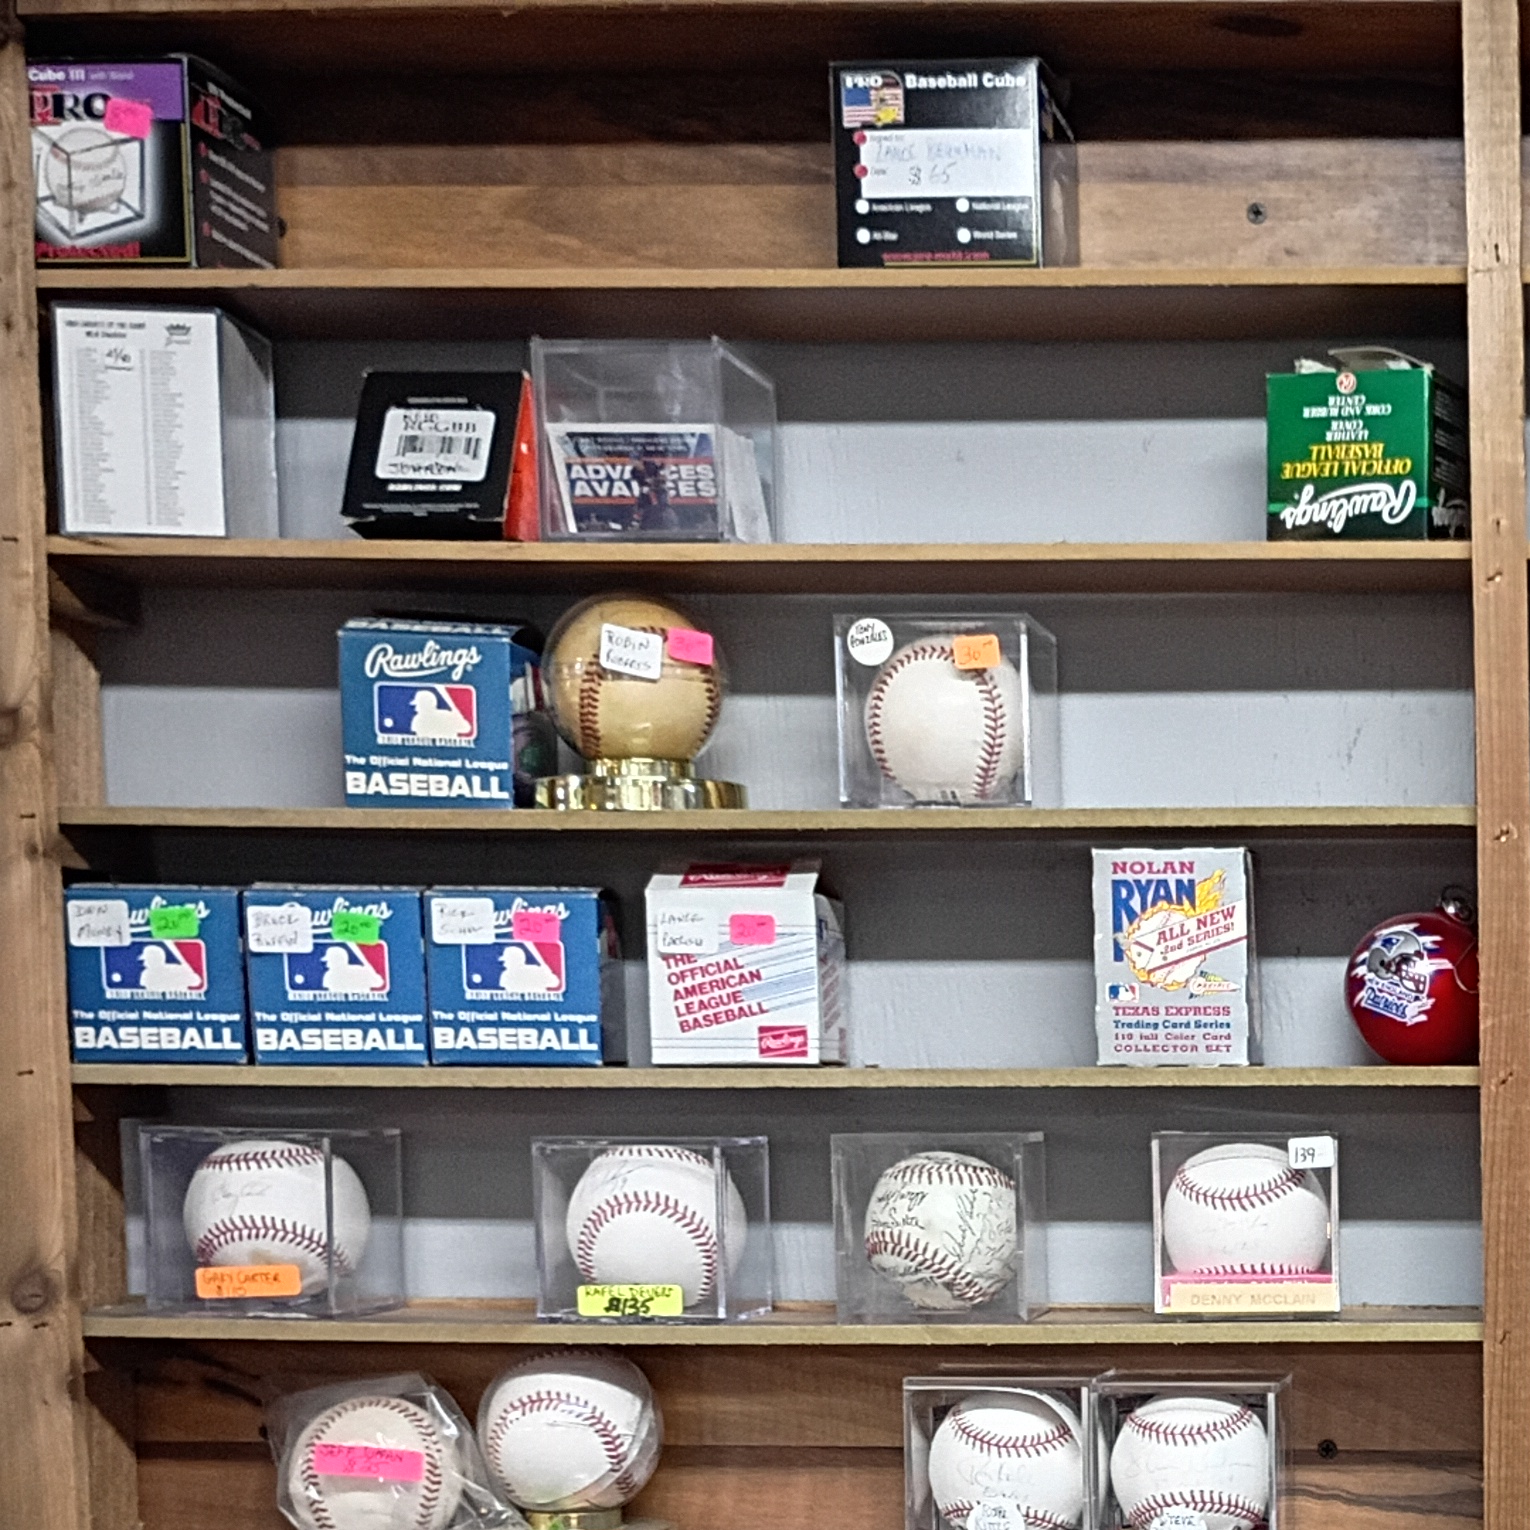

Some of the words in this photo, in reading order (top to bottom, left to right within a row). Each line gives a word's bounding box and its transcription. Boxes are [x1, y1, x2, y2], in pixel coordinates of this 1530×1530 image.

[904, 72, 978, 89] Baseball
[982, 73, 1026, 89] Cube
[1309, 443, 1385, 459] BASEBALL
[1280, 462, 1350, 480] LEAGUE
[1351, 459, 1412, 479] OFFICIAL
[1279, 481, 1418, 533] Rawlings
[365, 640, 482, 682] Rawlings
[345, 754, 367, 766] The
[369, 754, 409, 768] Official
[412, 756, 461, 768] National
[464, 758, 508, 771] League
[346, 771, 509, 799] BASEBALL
[1111, 861, 1195, 875] NOLAN
[1112, 878, 1196, 962] RYAN
[1156, 925, 1190, 946] ALL
[1195, 905, 1237, 933] NEW
[1186, 922, 1236, 949] SERIES!
[663, 954, 699, 970] THE
[667, 957, 744, 985] OFFICIAL
[673, 968, 763, 1001] AMERICAN
[673, 990, 744, 1018] LEAGUE
[1113, 1006, 1160, 1017] TEXAS
[1164, 1006, 1231, 1017] EXPRESS
[72, 1009, 97, 1021] The
[99, 1009, 139, 1022] Official
[144, 1010, 194, 1022] National
[196, 1011, 241, 1024] League
[255, 1011, 277, 1023] The
[279, 1011, 321, 1024] Official
[325, 1011, 376, 1023] National
[378, 1012, 423, 1025] League
[432, 1011, 455, 1022] The
[457, 1010, 498, 1024] Official
[501, 1010, 552, 1022] National
[554, 1012, 598, 1026] League
[678, 1001, 769, 1033] BASEBALL
[1113, 1019, 1159, 1031] Trading
[1162, 1019, 1191, 1030] Card
[1194, 1019, 1231, 1030] Series
[74, 1026, 243, 1050] BASEBALL
[255, 1027, 425, 1051] BASEBALL
[433, 1027, 599, 1051] BASEBALL
[1113, 1044, 1199, 1054] COLLECTOR
[1189, 1293, 1243, 1305] DENNY
[1250, 1293, 1317, 1305] MCCLAIN
